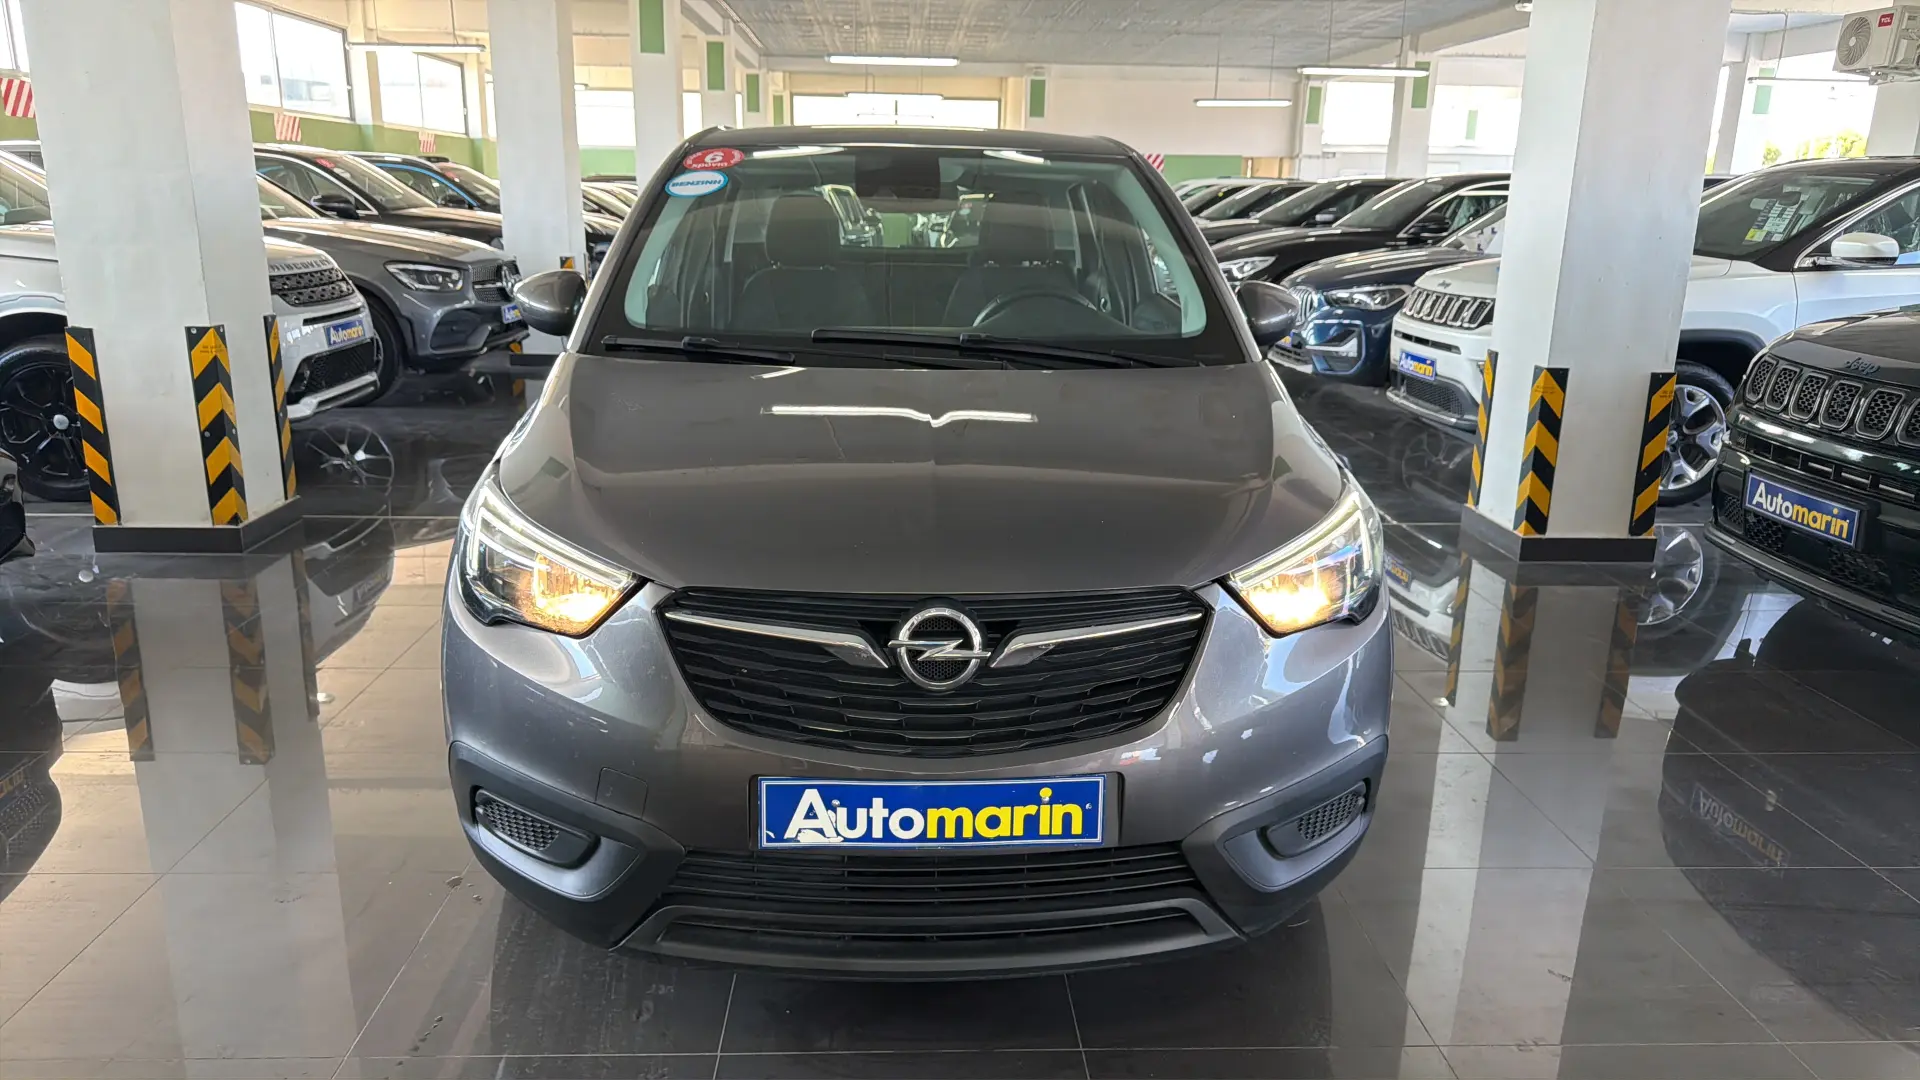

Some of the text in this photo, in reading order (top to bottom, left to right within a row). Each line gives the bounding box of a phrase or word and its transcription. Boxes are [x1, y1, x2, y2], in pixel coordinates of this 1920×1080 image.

[704, 152, 725, 164] 6
[330, 320, 364, 344] Automarin
[1844, 357, 1881, 376] Jeep
[1752, 482, 1849, 539] Automarin
[784, 787, 1083, 840] Automarin
